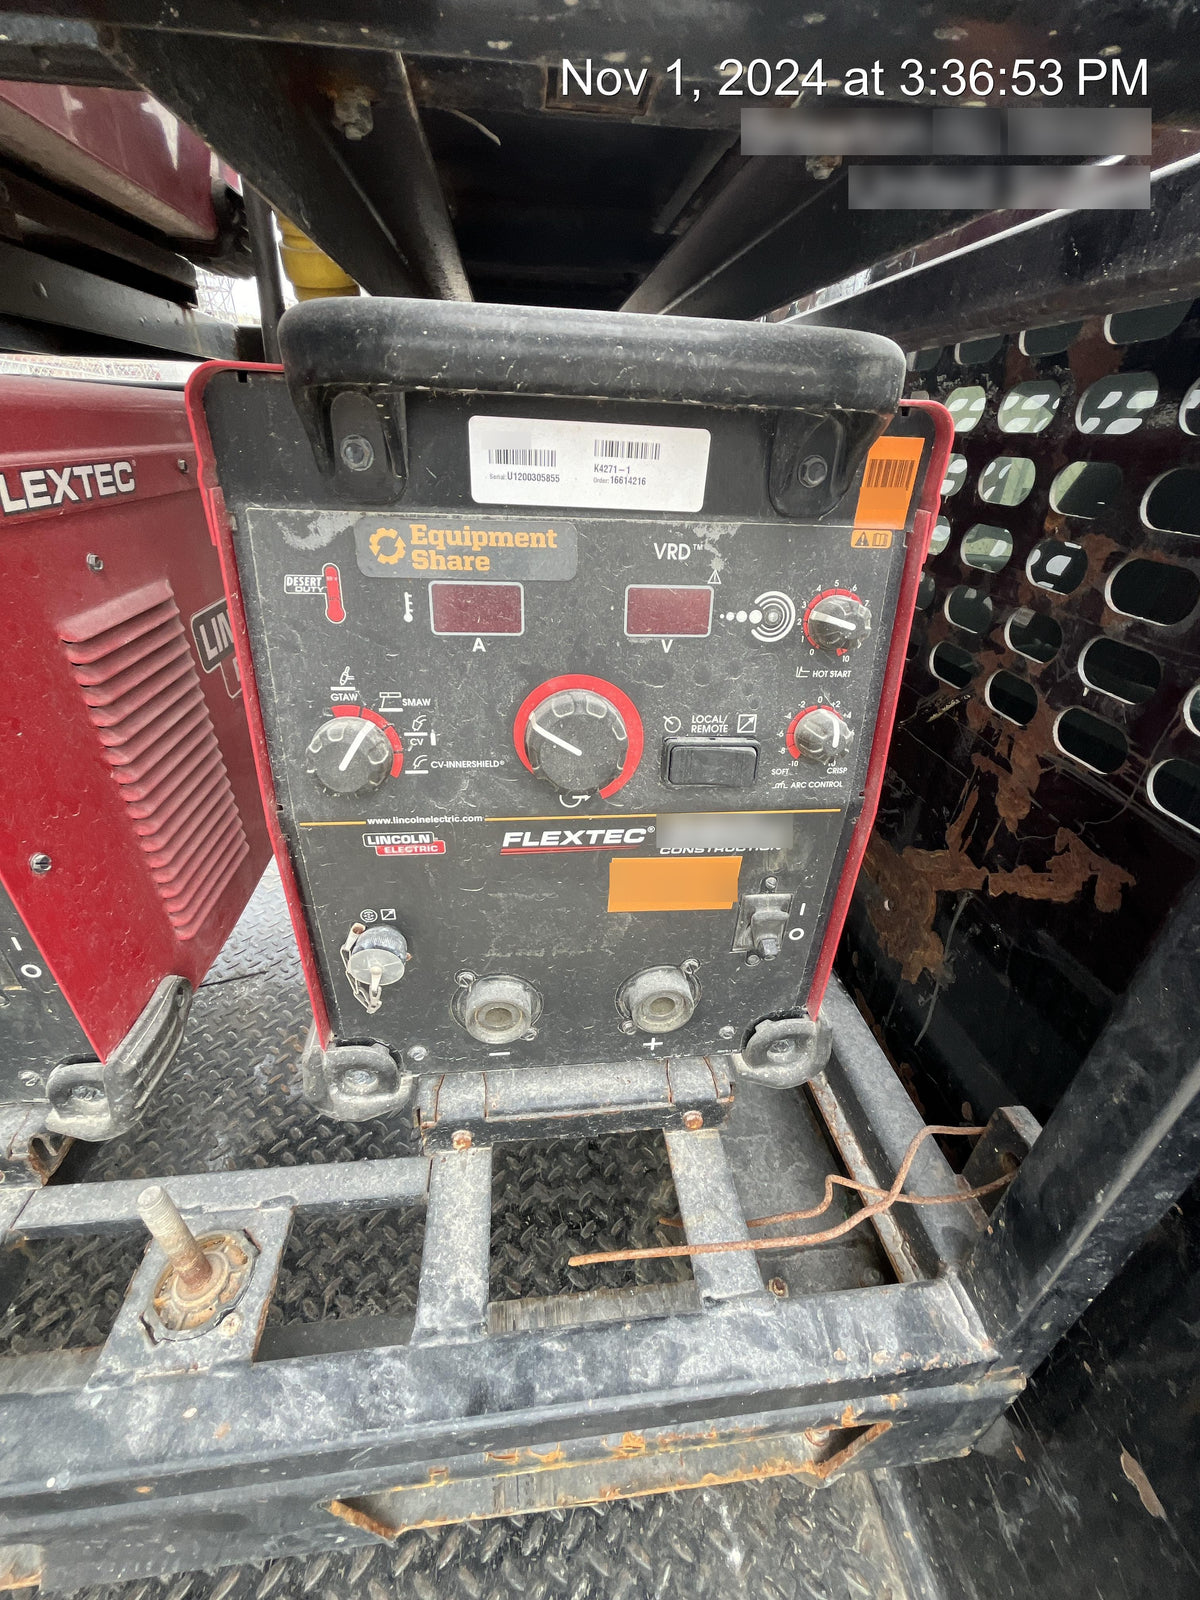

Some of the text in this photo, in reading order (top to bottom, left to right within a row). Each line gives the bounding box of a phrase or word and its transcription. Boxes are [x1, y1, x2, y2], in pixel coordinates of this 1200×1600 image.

[610, 476, 646, 486] 16614216
[410, 524, 557, 551] Equipment
[411, 549, 490, 571] Share
[286, 576, 322, 586] DESERT
[472, 638, 486, 652] A
[661, 639, 674, 654] V
[812, 670, 852, 678] HOT START
[330, 693, 358, 702] GTAW
[402, 698, 431, 707] SMAW
[691, 724, 728, 734] REMOTE
[410, 738, 424, 746] CV
[808, 780, 843, 788] CONTROL
[366, 815, 483, 826] www.lincolnelectric.com
[366, 834, 430, 846] LINCOLN
[384, 844, 439, 854] ELECTRIC
